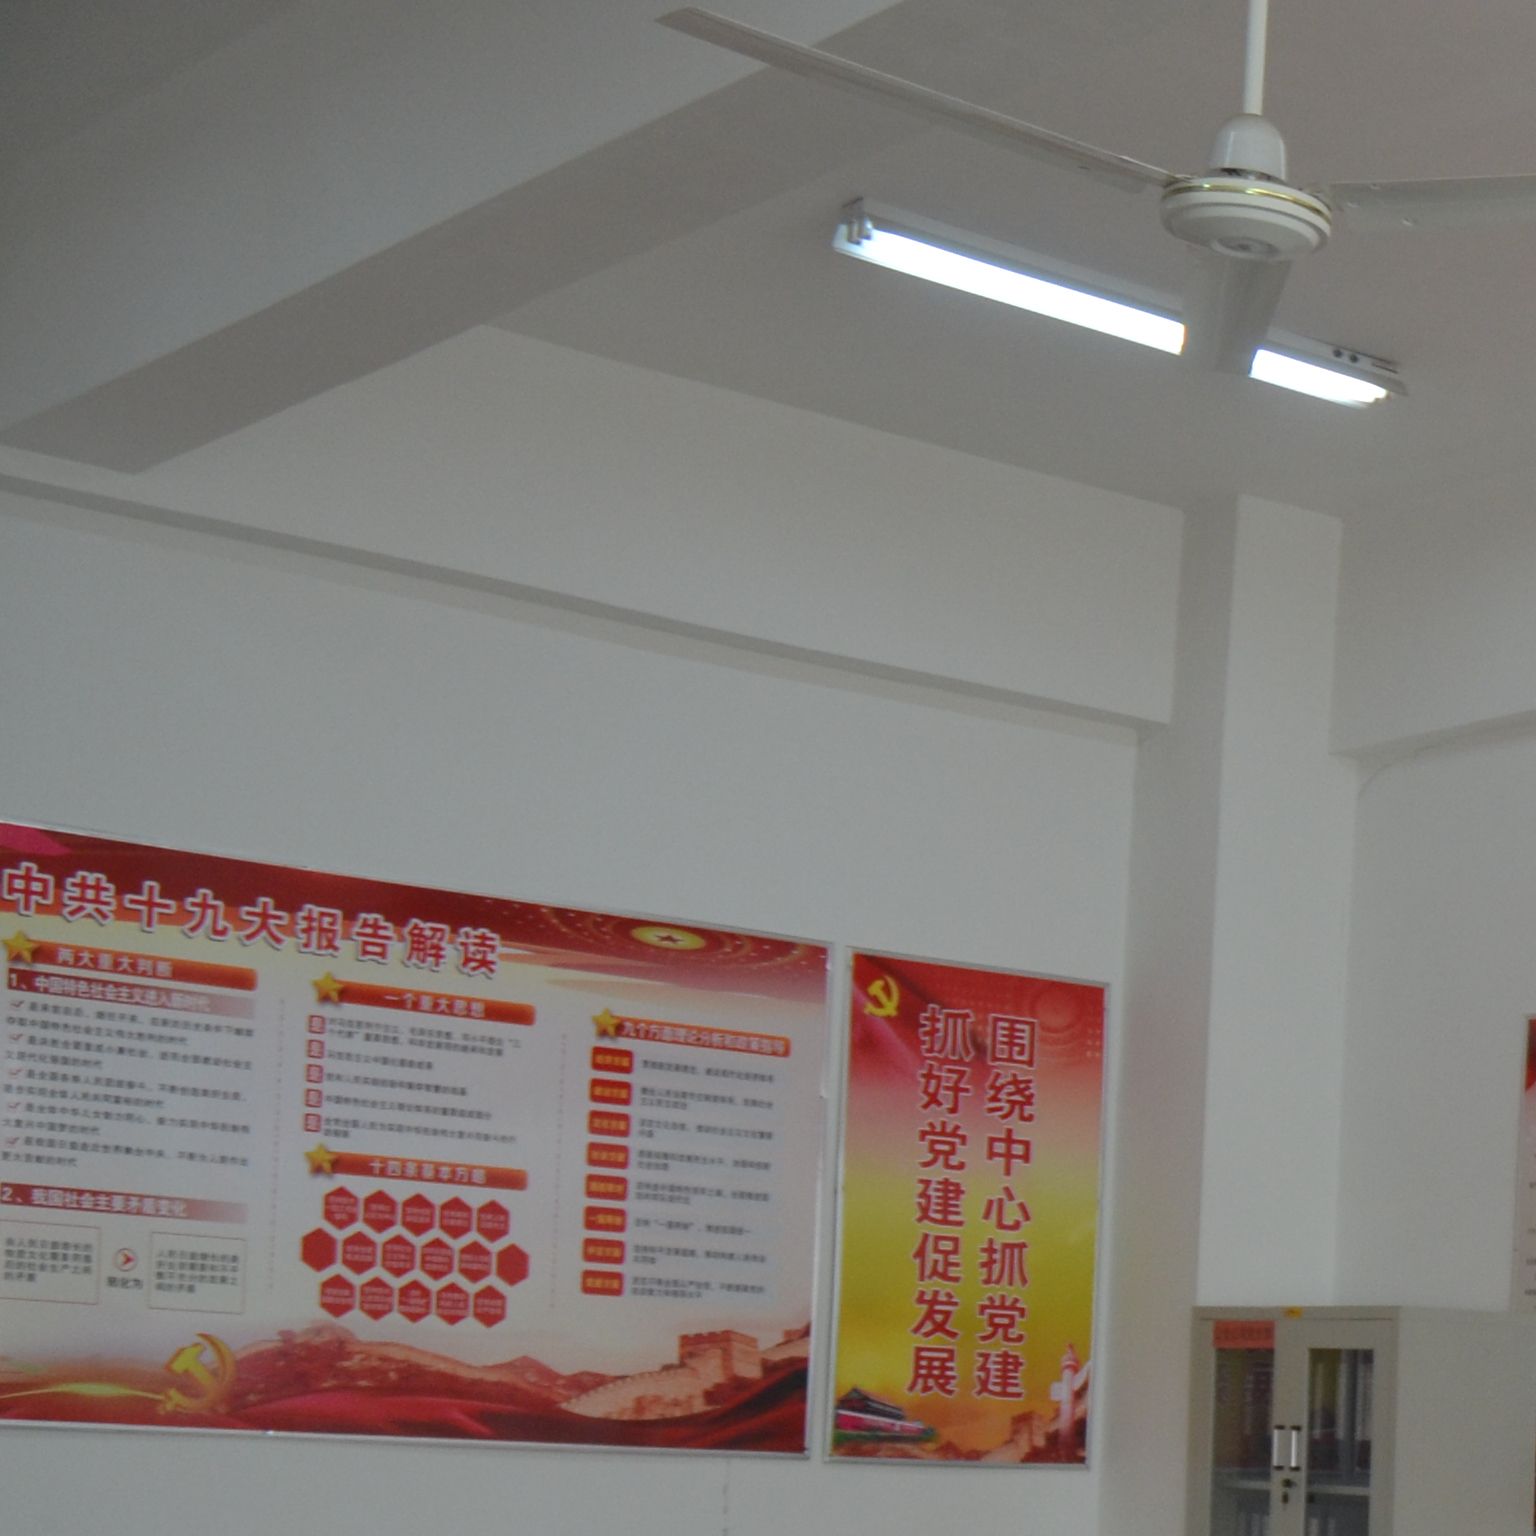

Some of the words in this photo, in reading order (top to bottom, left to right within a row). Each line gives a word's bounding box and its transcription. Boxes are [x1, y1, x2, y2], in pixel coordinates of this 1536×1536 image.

[3, 862, 501, 978] 中共十九大报告解读
[907, 1004, 976, 1399] 抓好党建促发展
[975, 1014, 1038, 1401] 围绕中心抓党建
